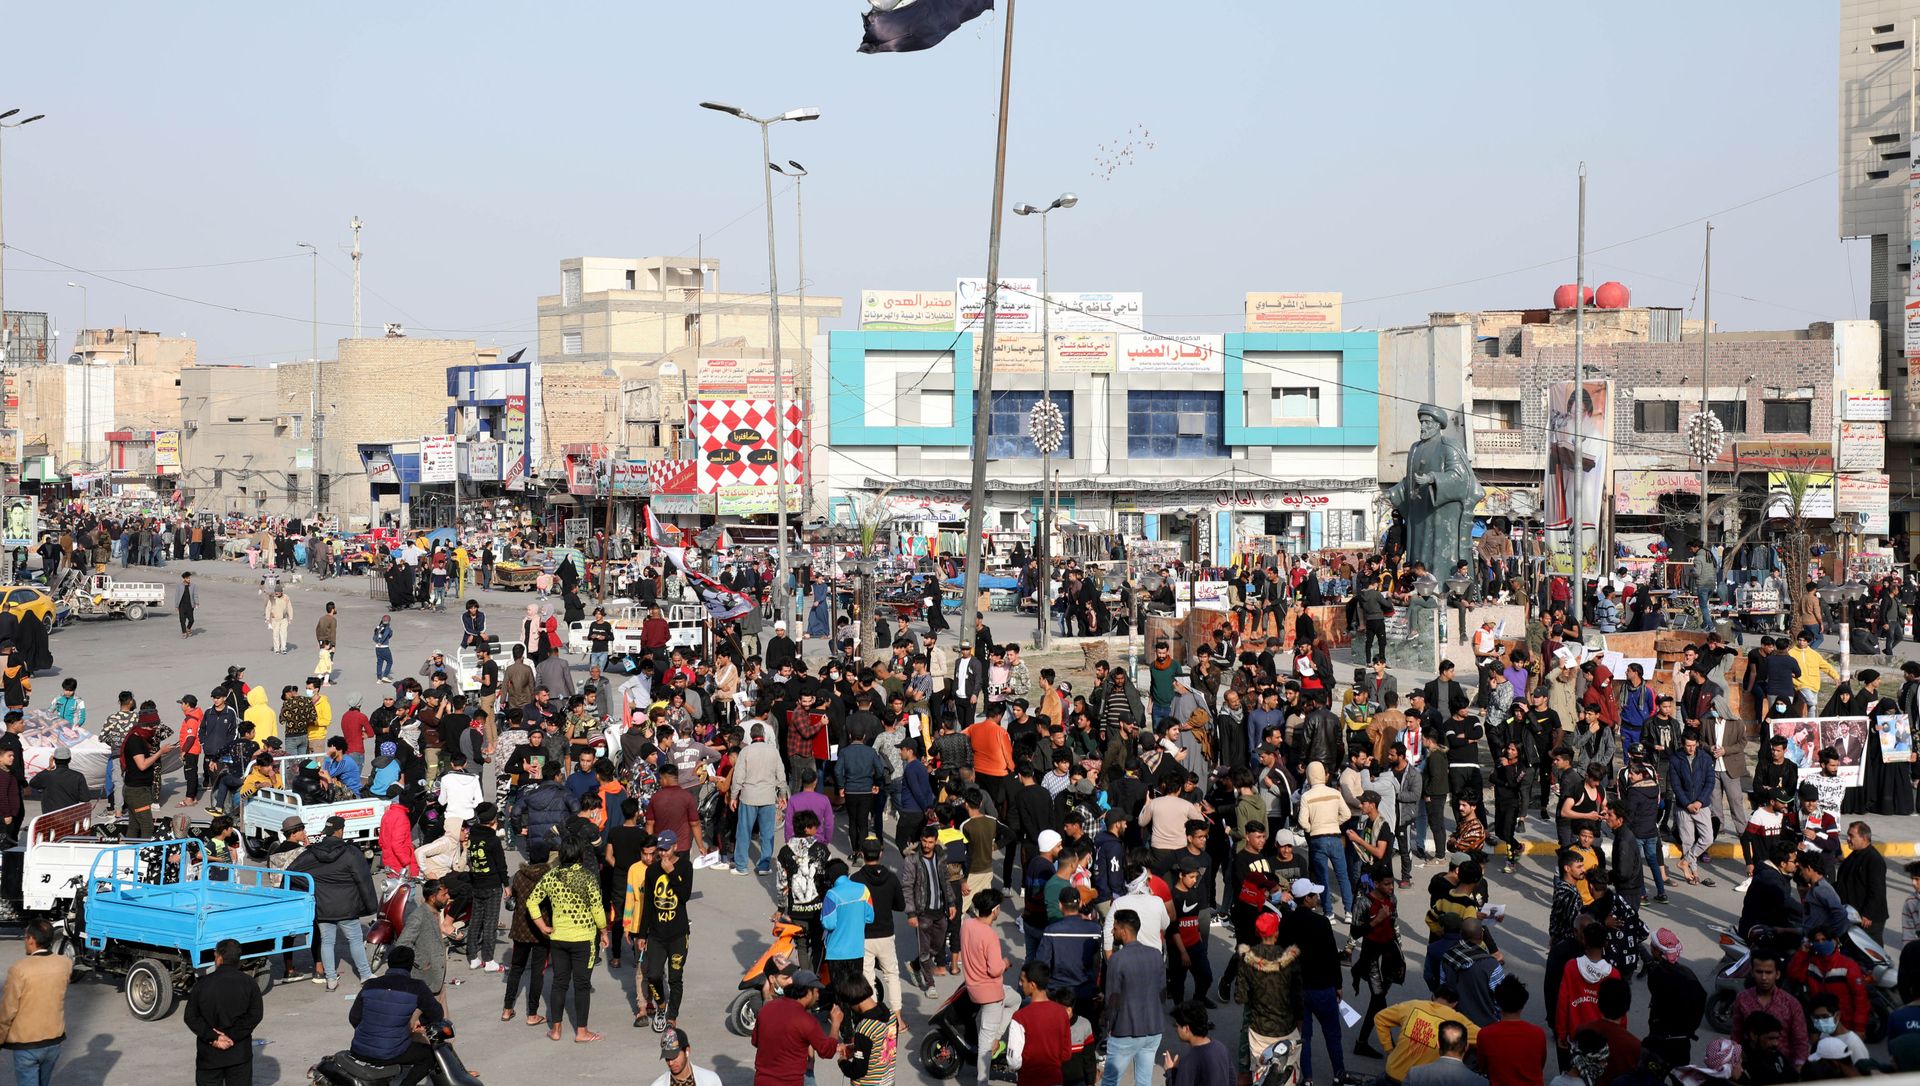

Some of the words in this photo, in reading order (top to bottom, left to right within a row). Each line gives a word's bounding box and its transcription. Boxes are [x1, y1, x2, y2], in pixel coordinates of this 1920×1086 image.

[884, 292, 922, 310] الهدى
[923, 297, 952, 309] مختبر
[1054, 300, 1083, 315] كشاش
[1085, 301, 1111, 314] كاظم
[1113, 301, 1138, 316] ناجي
[1255, 298, 1298, 311] المشرفاوي
[1299, 299, 1333, 310] عدنان
[864, 312, 900, 321] والهرمونات
[925, 312, 954, 320] للتحليلات
[1127, 343, 1169, 361] العضب
[1170, 342, 1212, 362] أزهار
[1215, 490, 1257, 508] العادل
[1282, 491, 1330, 509] صيدلية
